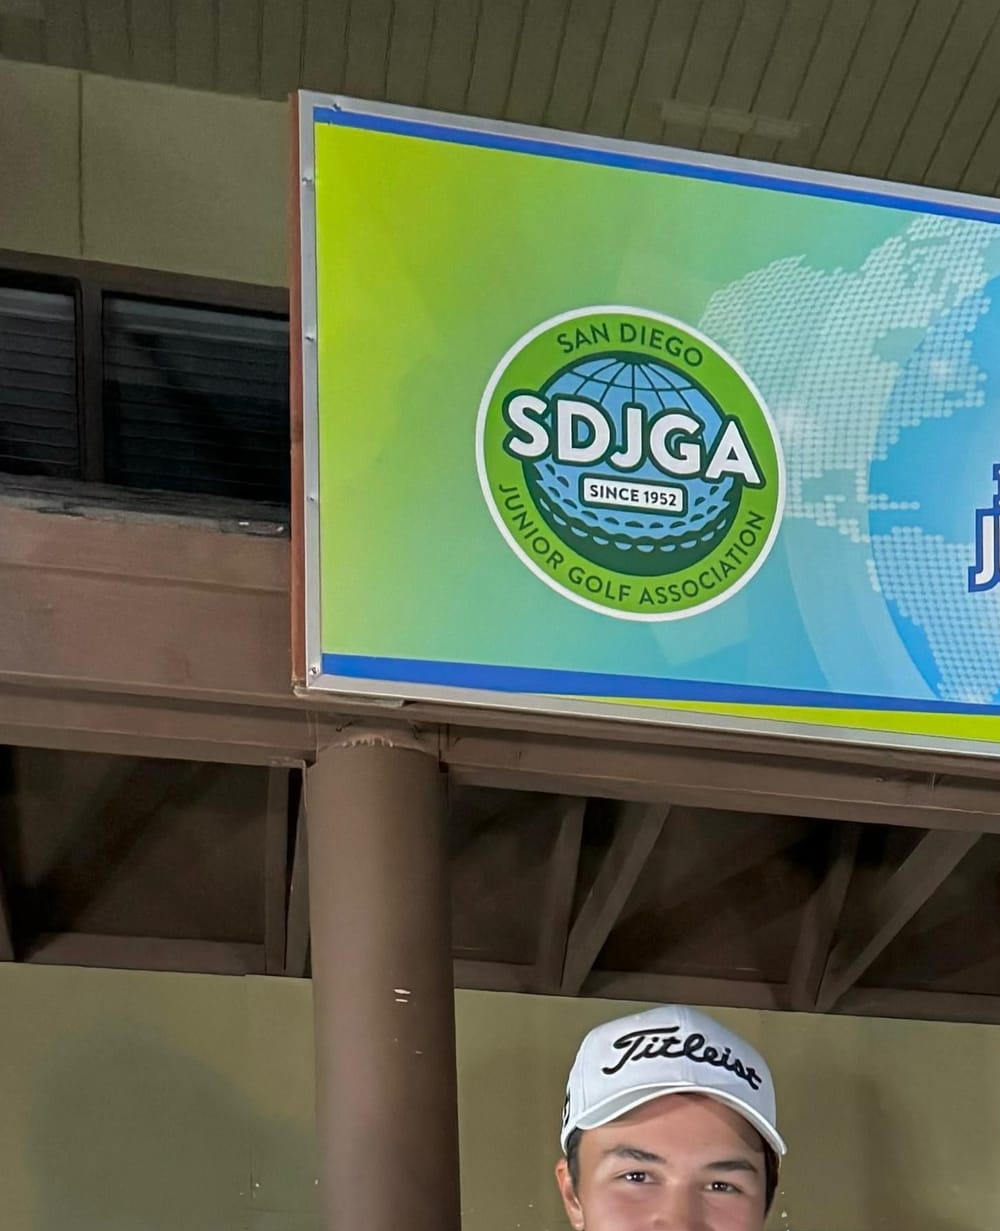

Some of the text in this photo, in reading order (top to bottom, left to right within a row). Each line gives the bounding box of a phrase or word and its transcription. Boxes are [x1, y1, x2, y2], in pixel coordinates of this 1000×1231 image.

[557, 322, 704, 367] SAN DIEGO
[506, 393, 763, 486] SDJGA
[590, 484, 677, 507] SINCE 1952
[499, 483, 766, 605] JUNIOR GOLF ASSOCIATION
[602, 1026, 762, 1090] Titleist
